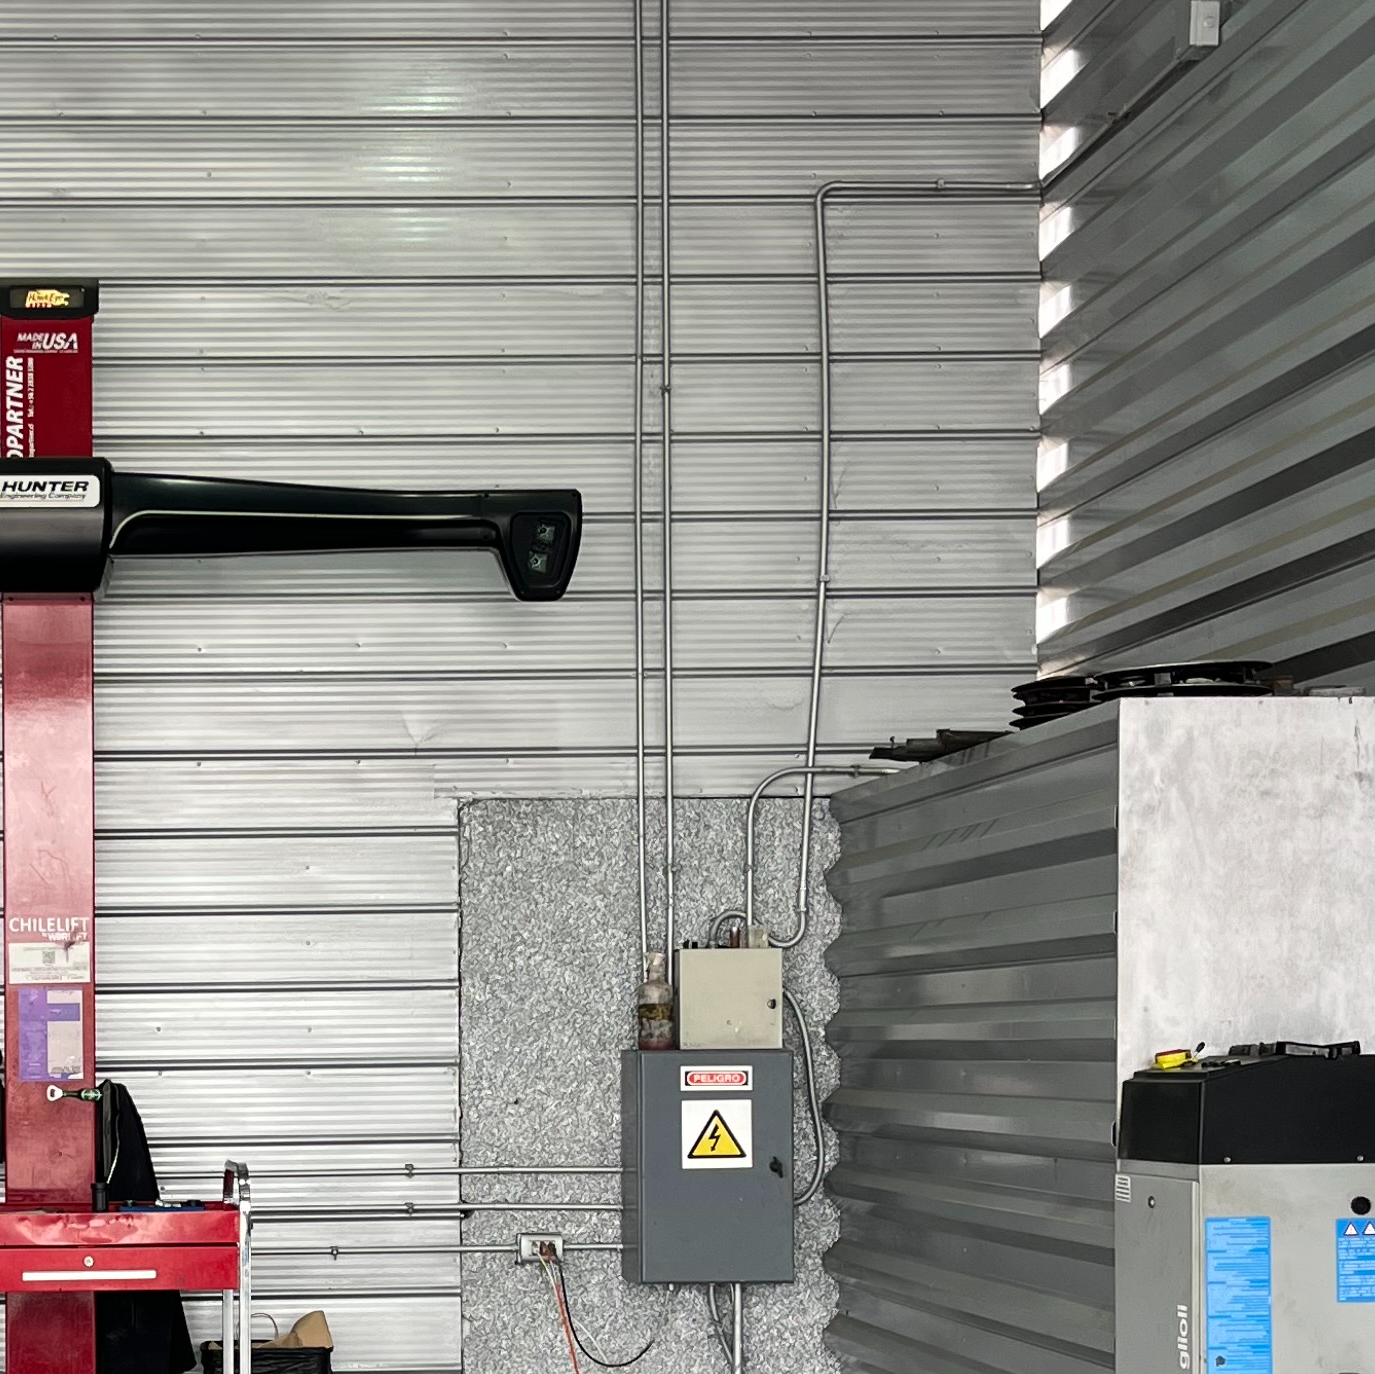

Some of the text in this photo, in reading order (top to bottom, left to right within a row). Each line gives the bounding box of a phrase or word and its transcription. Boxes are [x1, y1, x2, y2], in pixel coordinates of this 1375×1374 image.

[17, 333, 43, 341] MADE
[42, 333, 78, 350] USA
[32, 342, 43, 350] IN
[2, 481, 89, 492] HUNTER
[0, 492, 87, 500] Engineering Company
[9, 917, 90, 932] CHILELIFT
[693, 1074, 741, 1083] PELIGRO
